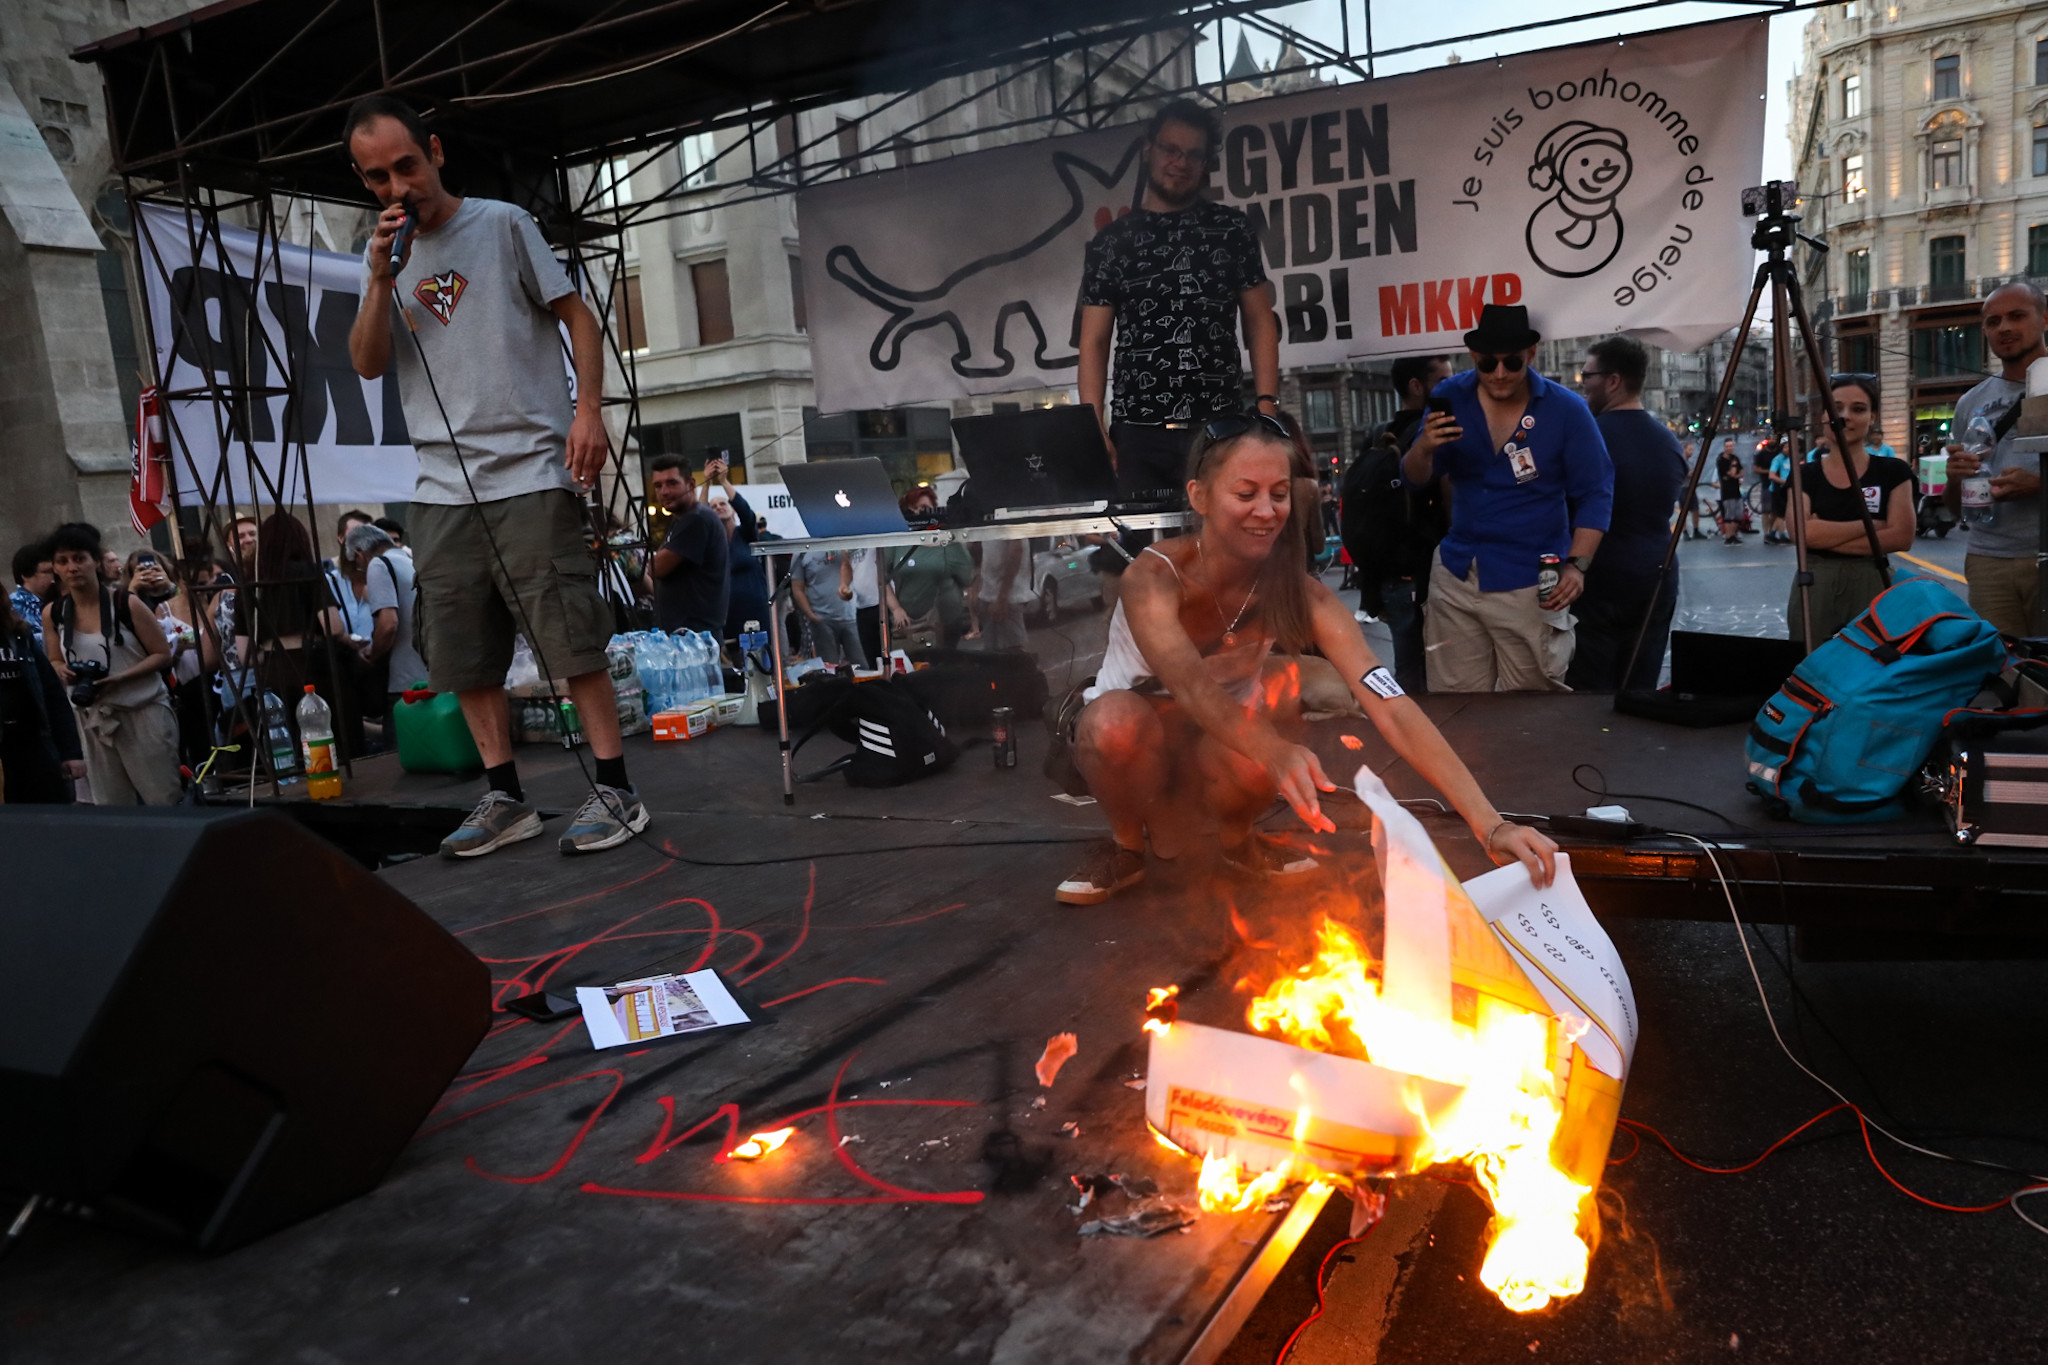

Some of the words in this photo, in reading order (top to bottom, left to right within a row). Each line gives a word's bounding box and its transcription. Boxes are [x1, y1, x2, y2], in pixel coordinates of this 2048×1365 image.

[1474, 107, 1524, 166] suis
[1528, 68, 1699, 157] bonhomme
[1206, 103, 1390, 201] EGYEN
[1682, 165, 1714, 211] de
[1244, 179, 1418, 270] NDEN
[1613, 224, 1693, 307] neige
[1379, 273, 1522, 337] MKKP
[768, 495, 794, 509] LEGY
